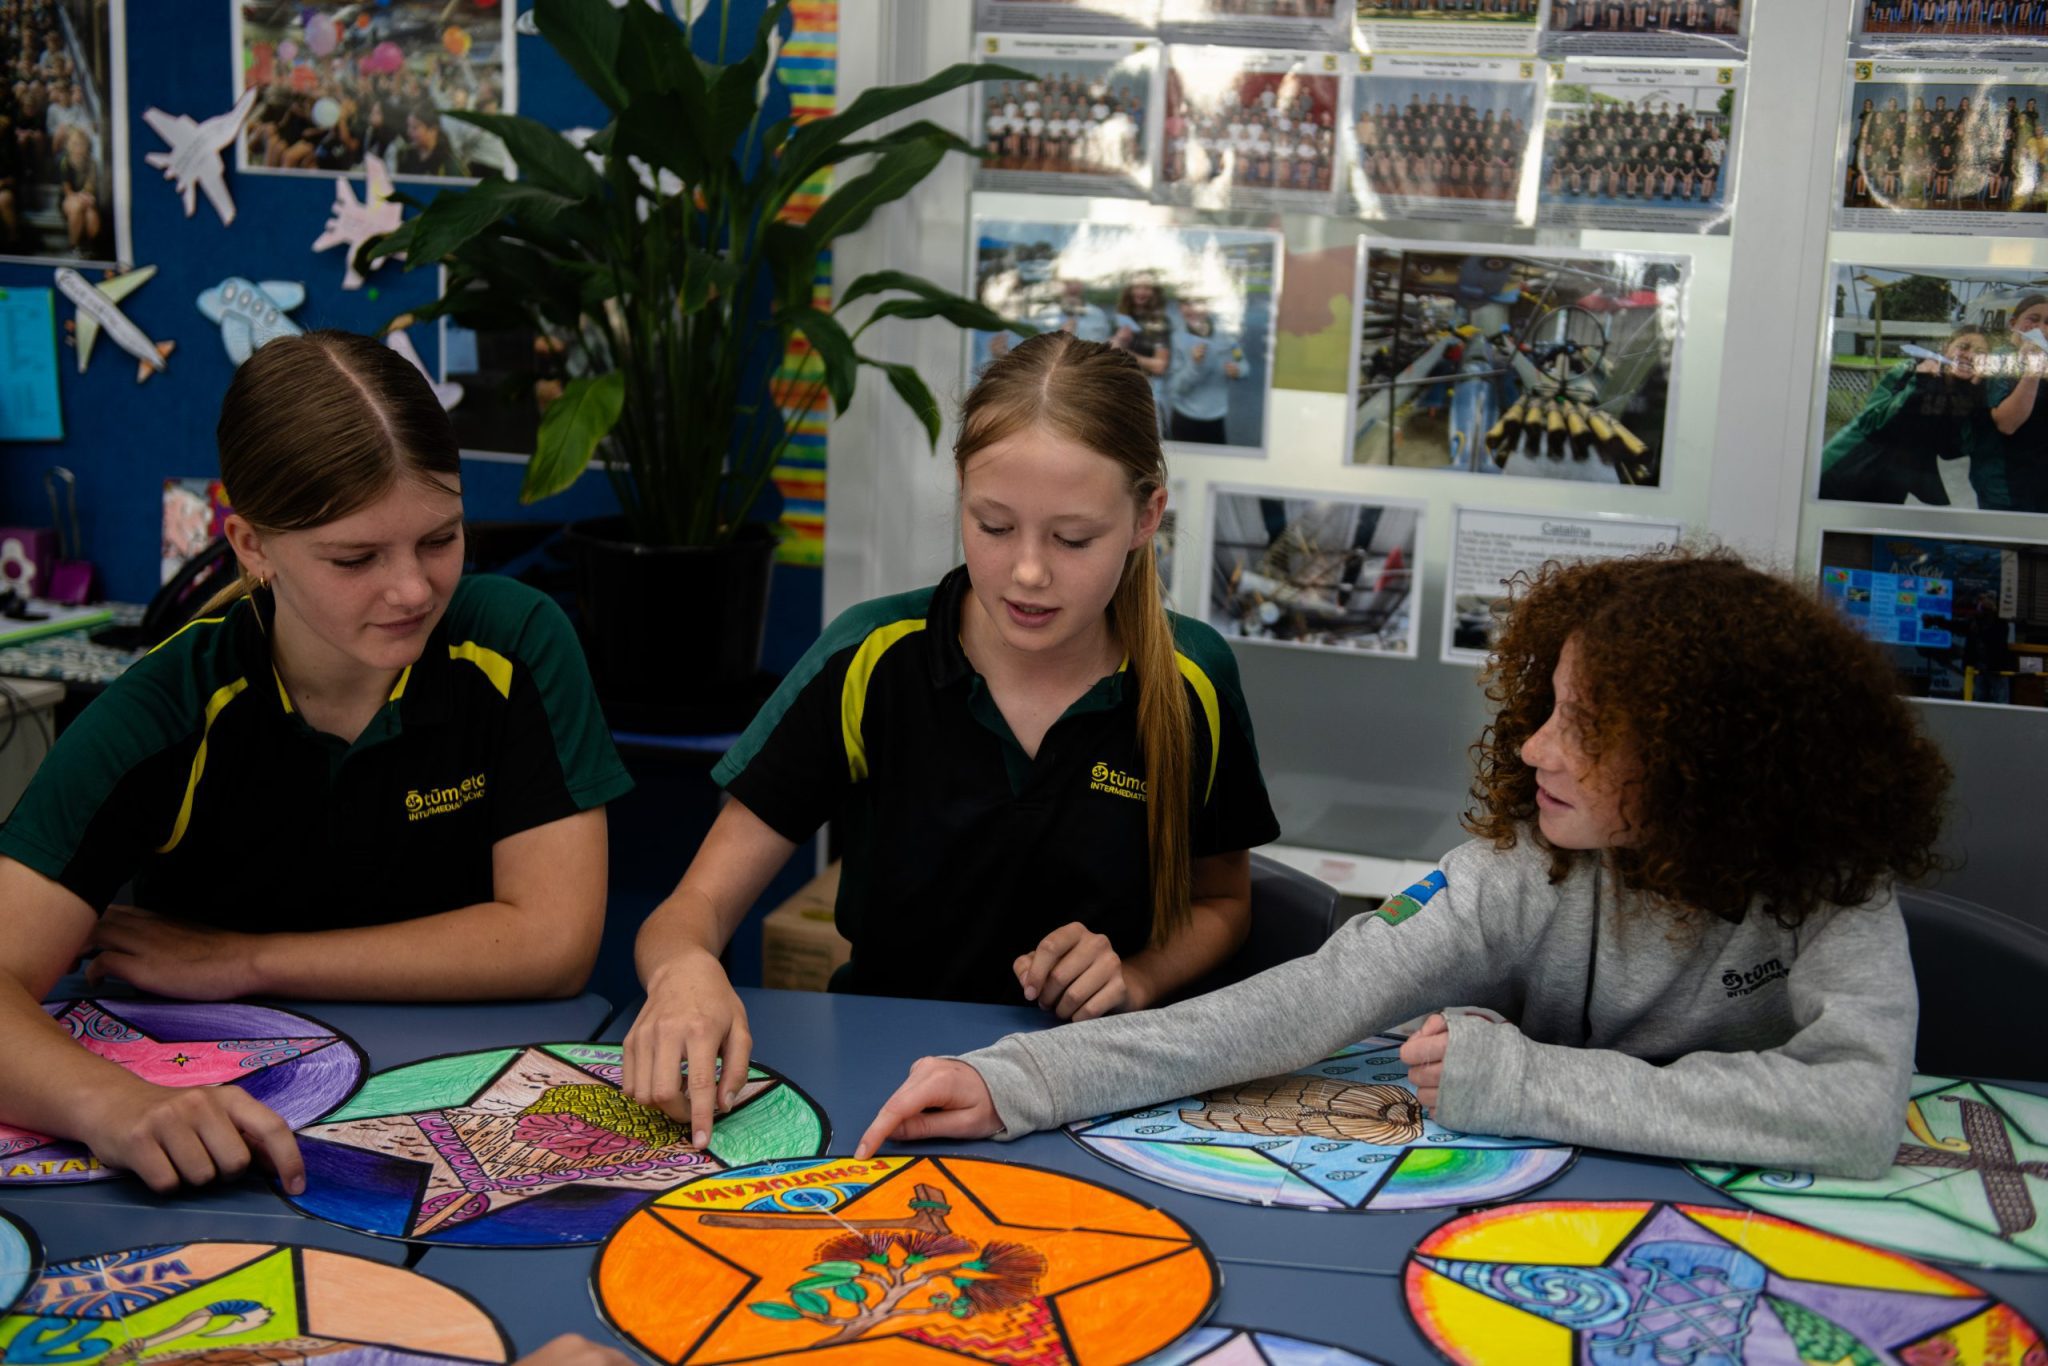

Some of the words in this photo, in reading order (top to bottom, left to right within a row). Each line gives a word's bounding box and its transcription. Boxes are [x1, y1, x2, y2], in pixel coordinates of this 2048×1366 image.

[1970, 66, 1999, 75] School
[1541, 521, 1591, 537] Catalina
[682, 1159, 893, 1204] PŌHUTUKAWA
